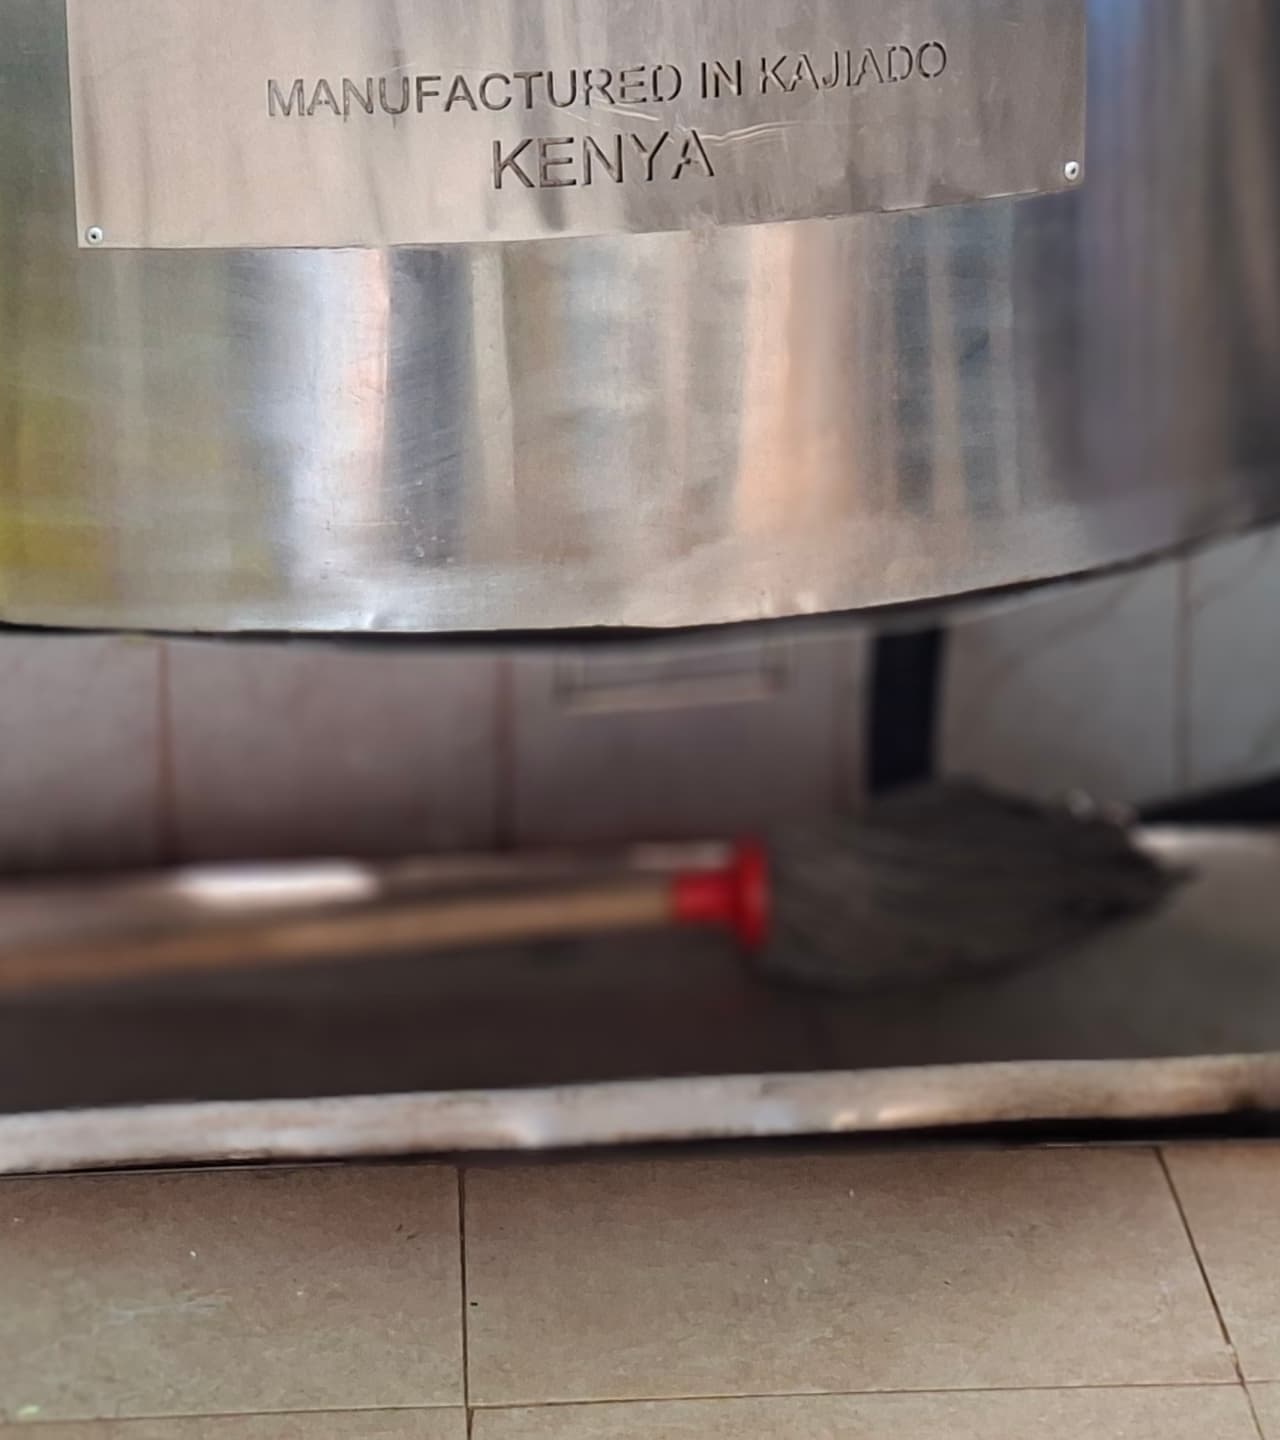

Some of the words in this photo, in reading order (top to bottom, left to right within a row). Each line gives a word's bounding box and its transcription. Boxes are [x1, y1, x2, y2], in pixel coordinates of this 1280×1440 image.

[267, 63, 681, 118] MANUFACTURED
[700, 56, 743, 100] IN
[760, 40, 947, 95] KAJIADO
[491, 129, 716, 189] KENYA
